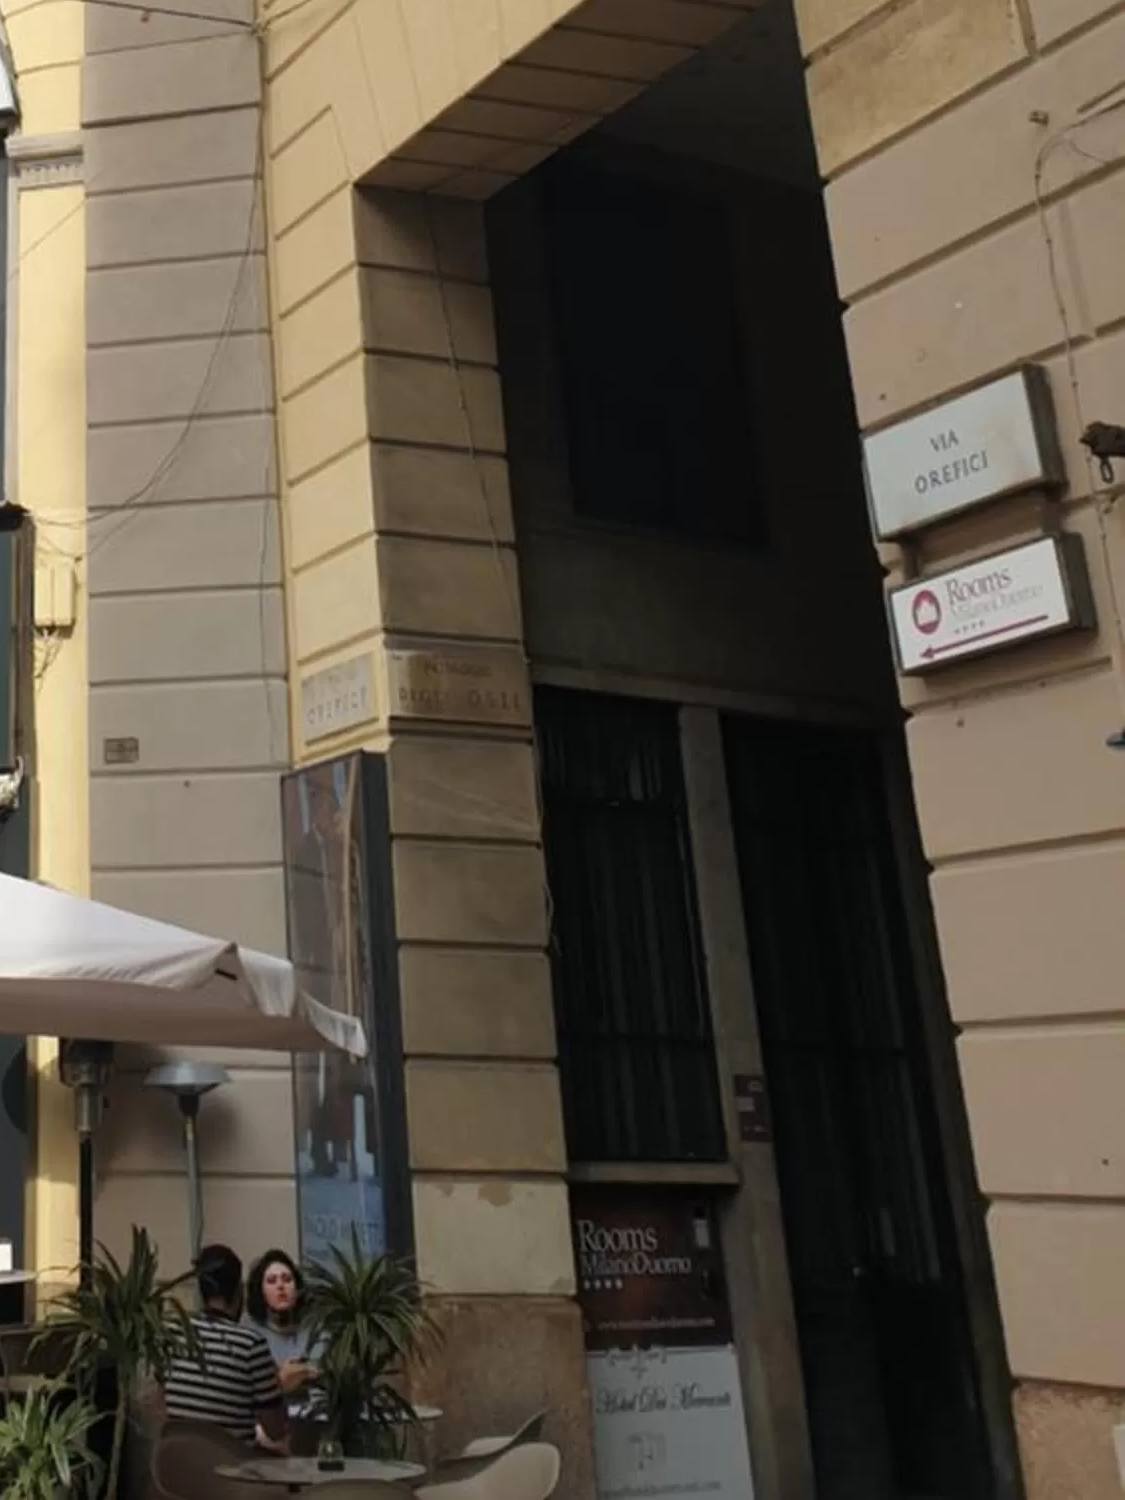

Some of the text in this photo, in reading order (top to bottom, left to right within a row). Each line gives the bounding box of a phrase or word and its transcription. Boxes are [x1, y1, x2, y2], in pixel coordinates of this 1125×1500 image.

[930, 429, 960, 453] VIA
[914, 449, 989, 494] OREFICI
[945, 567, 1014, 606] Rooms
[577, 1218, 659, 1253] Rooms
